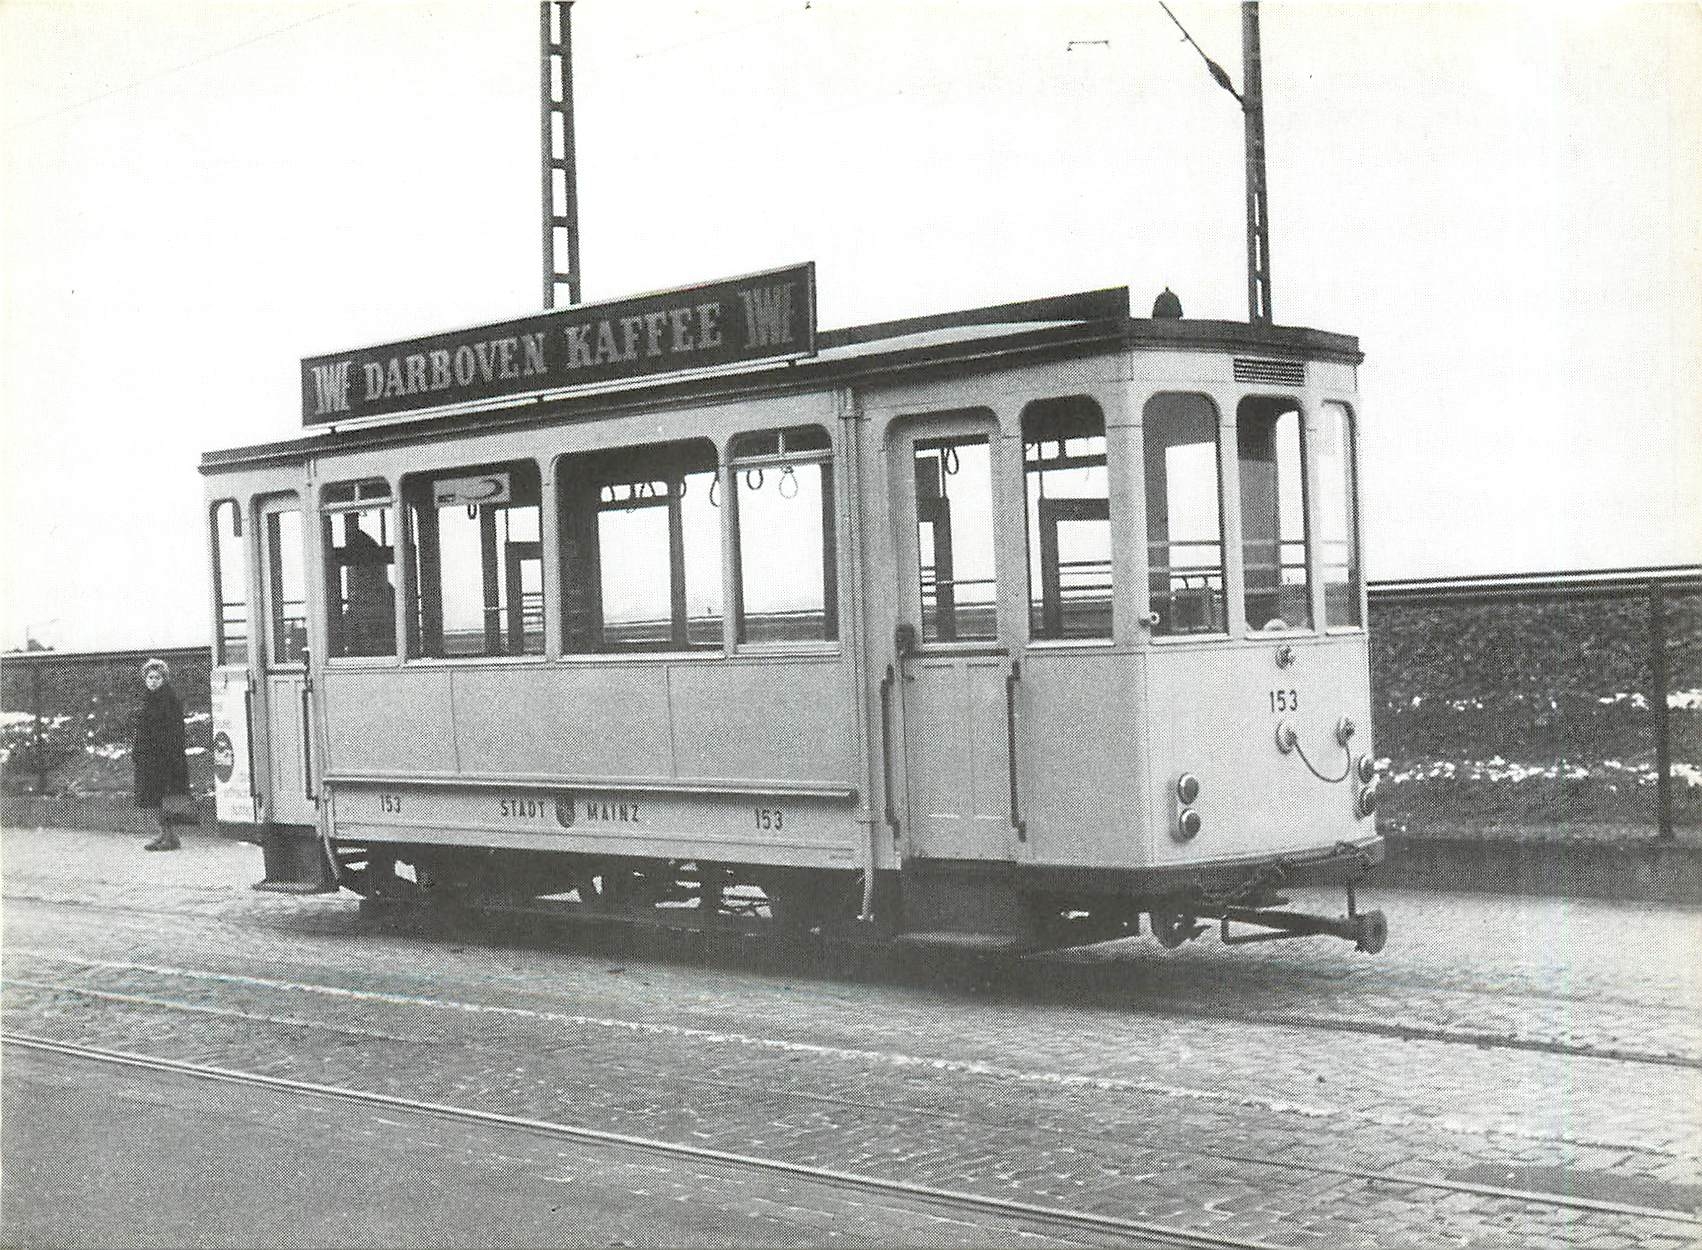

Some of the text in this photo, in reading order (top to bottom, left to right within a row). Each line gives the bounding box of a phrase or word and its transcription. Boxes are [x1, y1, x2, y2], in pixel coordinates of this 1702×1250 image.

[363, 332, 547, 401] DARBOVEN
[564, 301, 723, 369] KAFFEE
[1270, 690, 1299, 713] 153
[379, 795, 402, 814] 153
[499, 799, 640, 824] STADT MAINZ
[754, 807, 784, 831] 153
